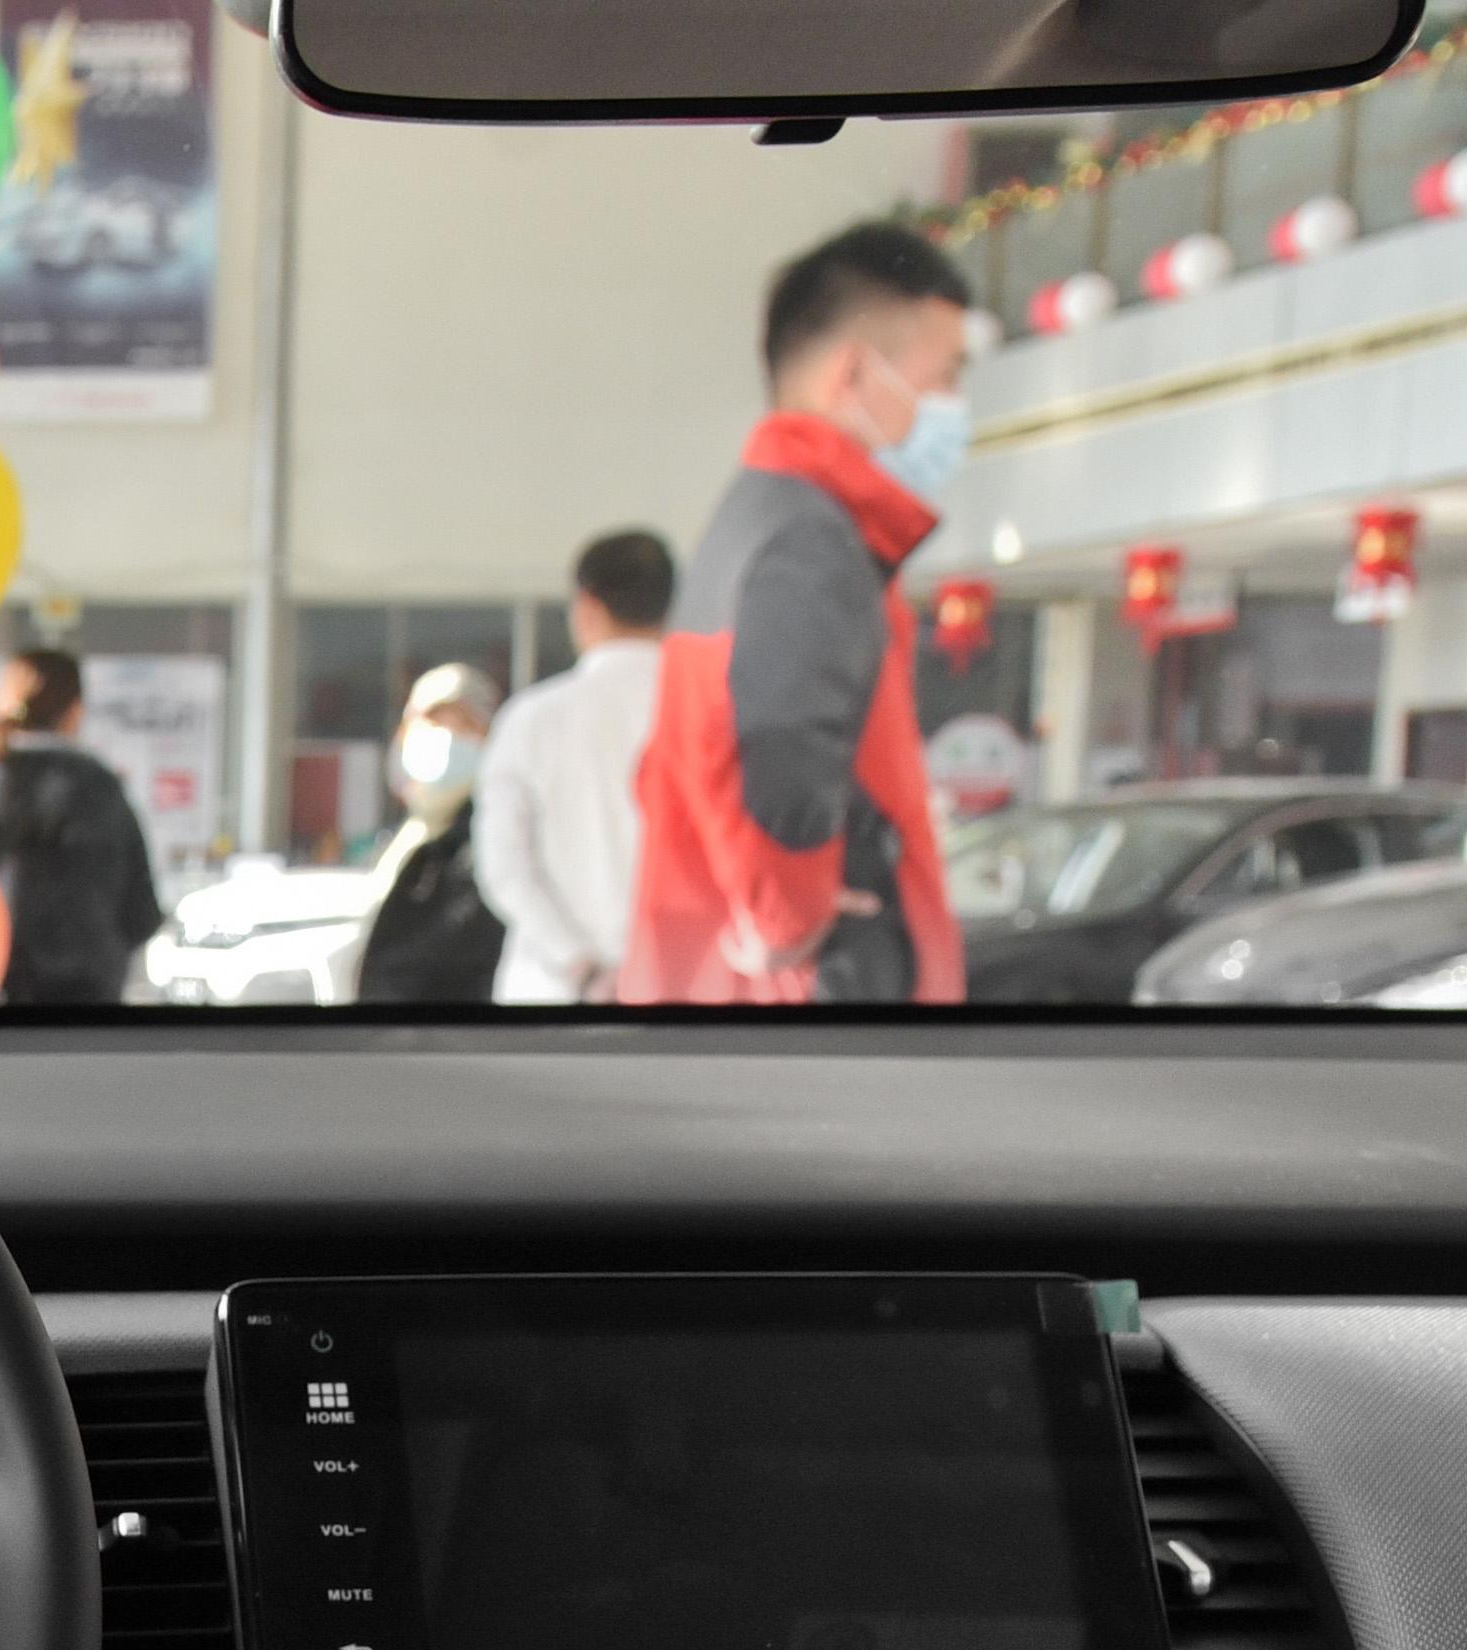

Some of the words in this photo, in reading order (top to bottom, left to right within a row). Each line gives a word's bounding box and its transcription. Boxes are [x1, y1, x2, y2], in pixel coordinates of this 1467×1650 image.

[306, 1411, 355, 1424] HOME
[313, 1459, 359, 1472] VOL+
[320, 1525, 366, 1536] VOL-
[328, 1589, 373, 1601] MUTE
